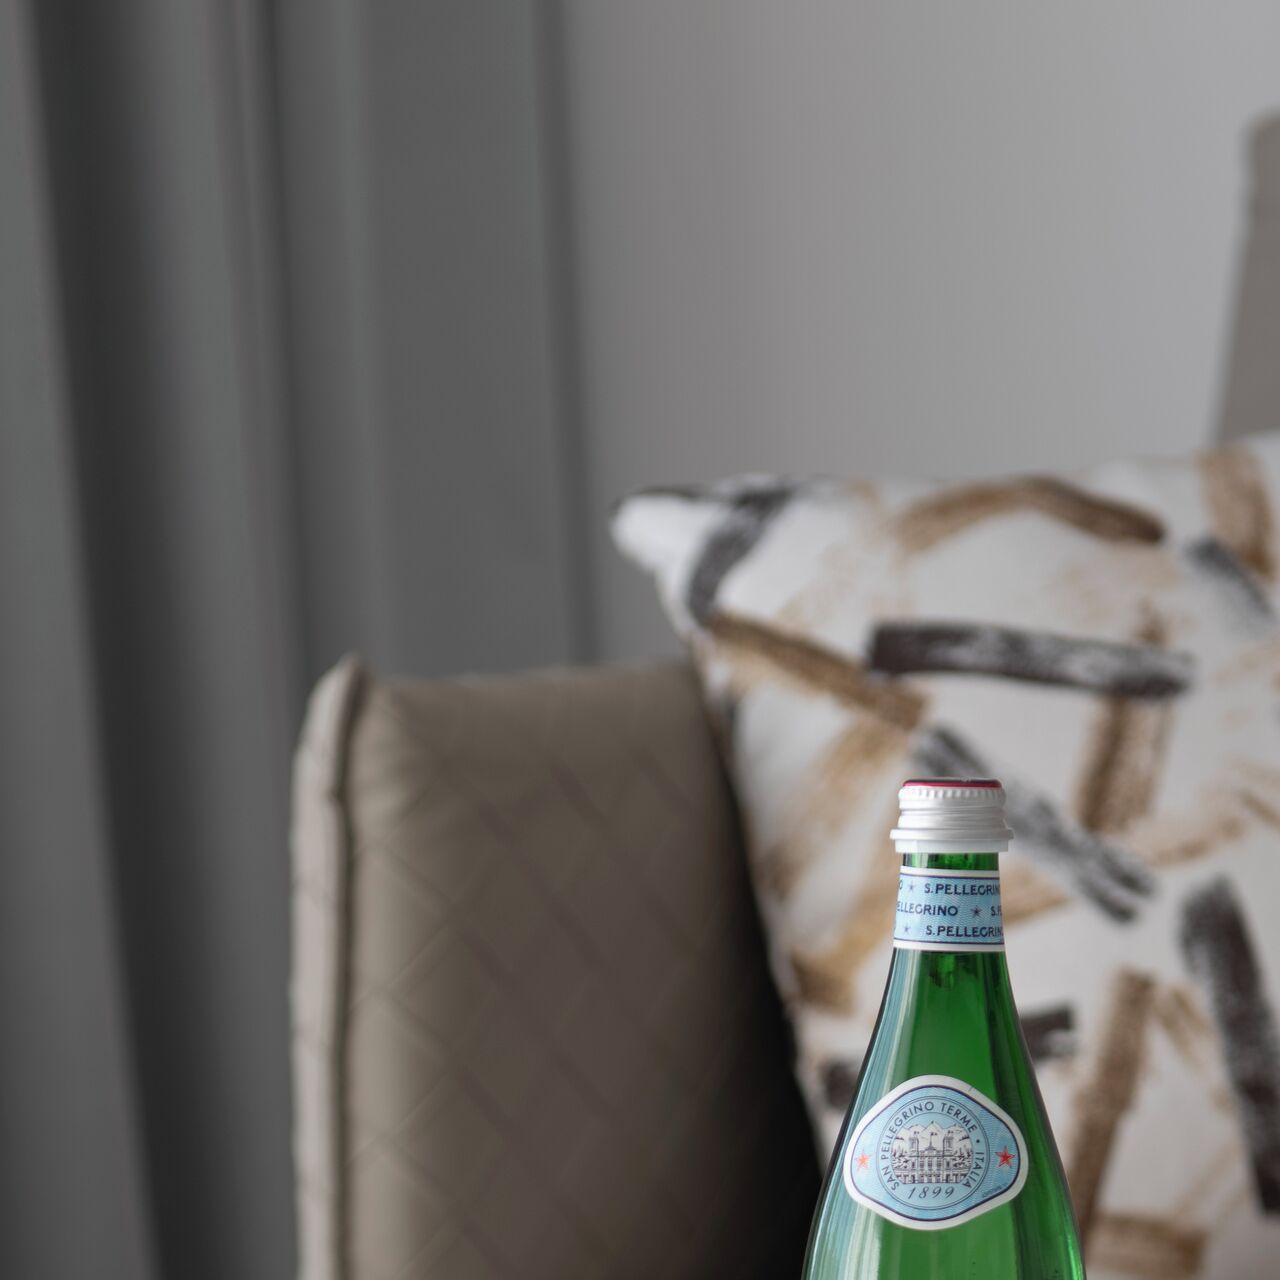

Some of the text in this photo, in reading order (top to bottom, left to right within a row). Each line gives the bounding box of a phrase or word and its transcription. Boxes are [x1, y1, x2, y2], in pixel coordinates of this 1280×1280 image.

[880, 1100, 985, 1191] SAN PELLEGRINO TERME ITALIA
[907, 1186, 956, 1200] 1899
